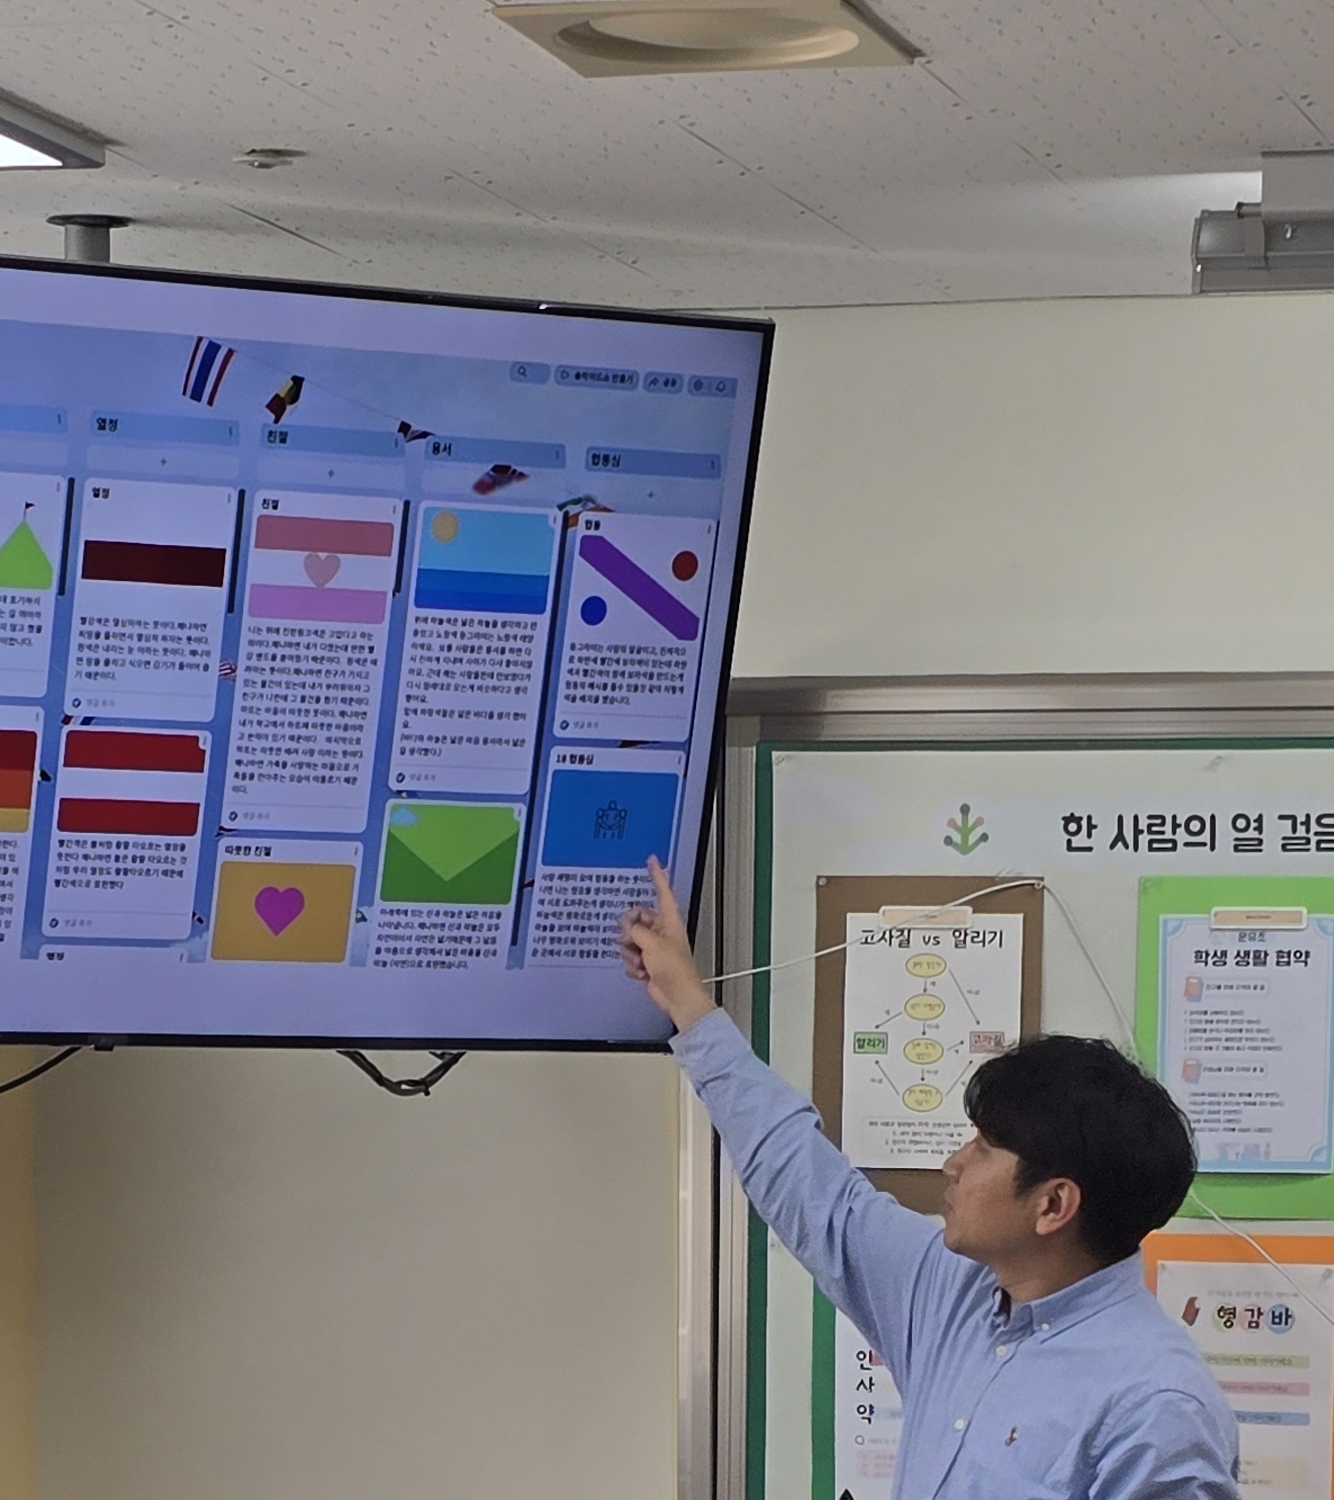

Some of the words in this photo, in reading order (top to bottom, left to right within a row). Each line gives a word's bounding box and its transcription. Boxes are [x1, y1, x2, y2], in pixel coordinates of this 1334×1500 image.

[96, 418, 118, 432] 열정
[267, 430, 288, 445] 친절
[432, 442, 452, 456] 용서
[591, 453, 621, 468] 협동심
[91, 486, 110, 500] 열정
[261, 499, 279, 512] 친절
[1062, 812, 1097, 852] 한
[1109, 812, 1218, 853] 사람의
[1230, 812, 1265, 853] 열
[255, 846, 272, 858] 친절
[922, 933, 941, 946] vs
[952, 930, 1004, 949] 알리기
[1194, 950, 1228, 967] 학생
[1234, 950, 1269, 967] 생활
[1275, 950, 1311, 967] 협약
[856, 1037, 885, 1050] 알리기
